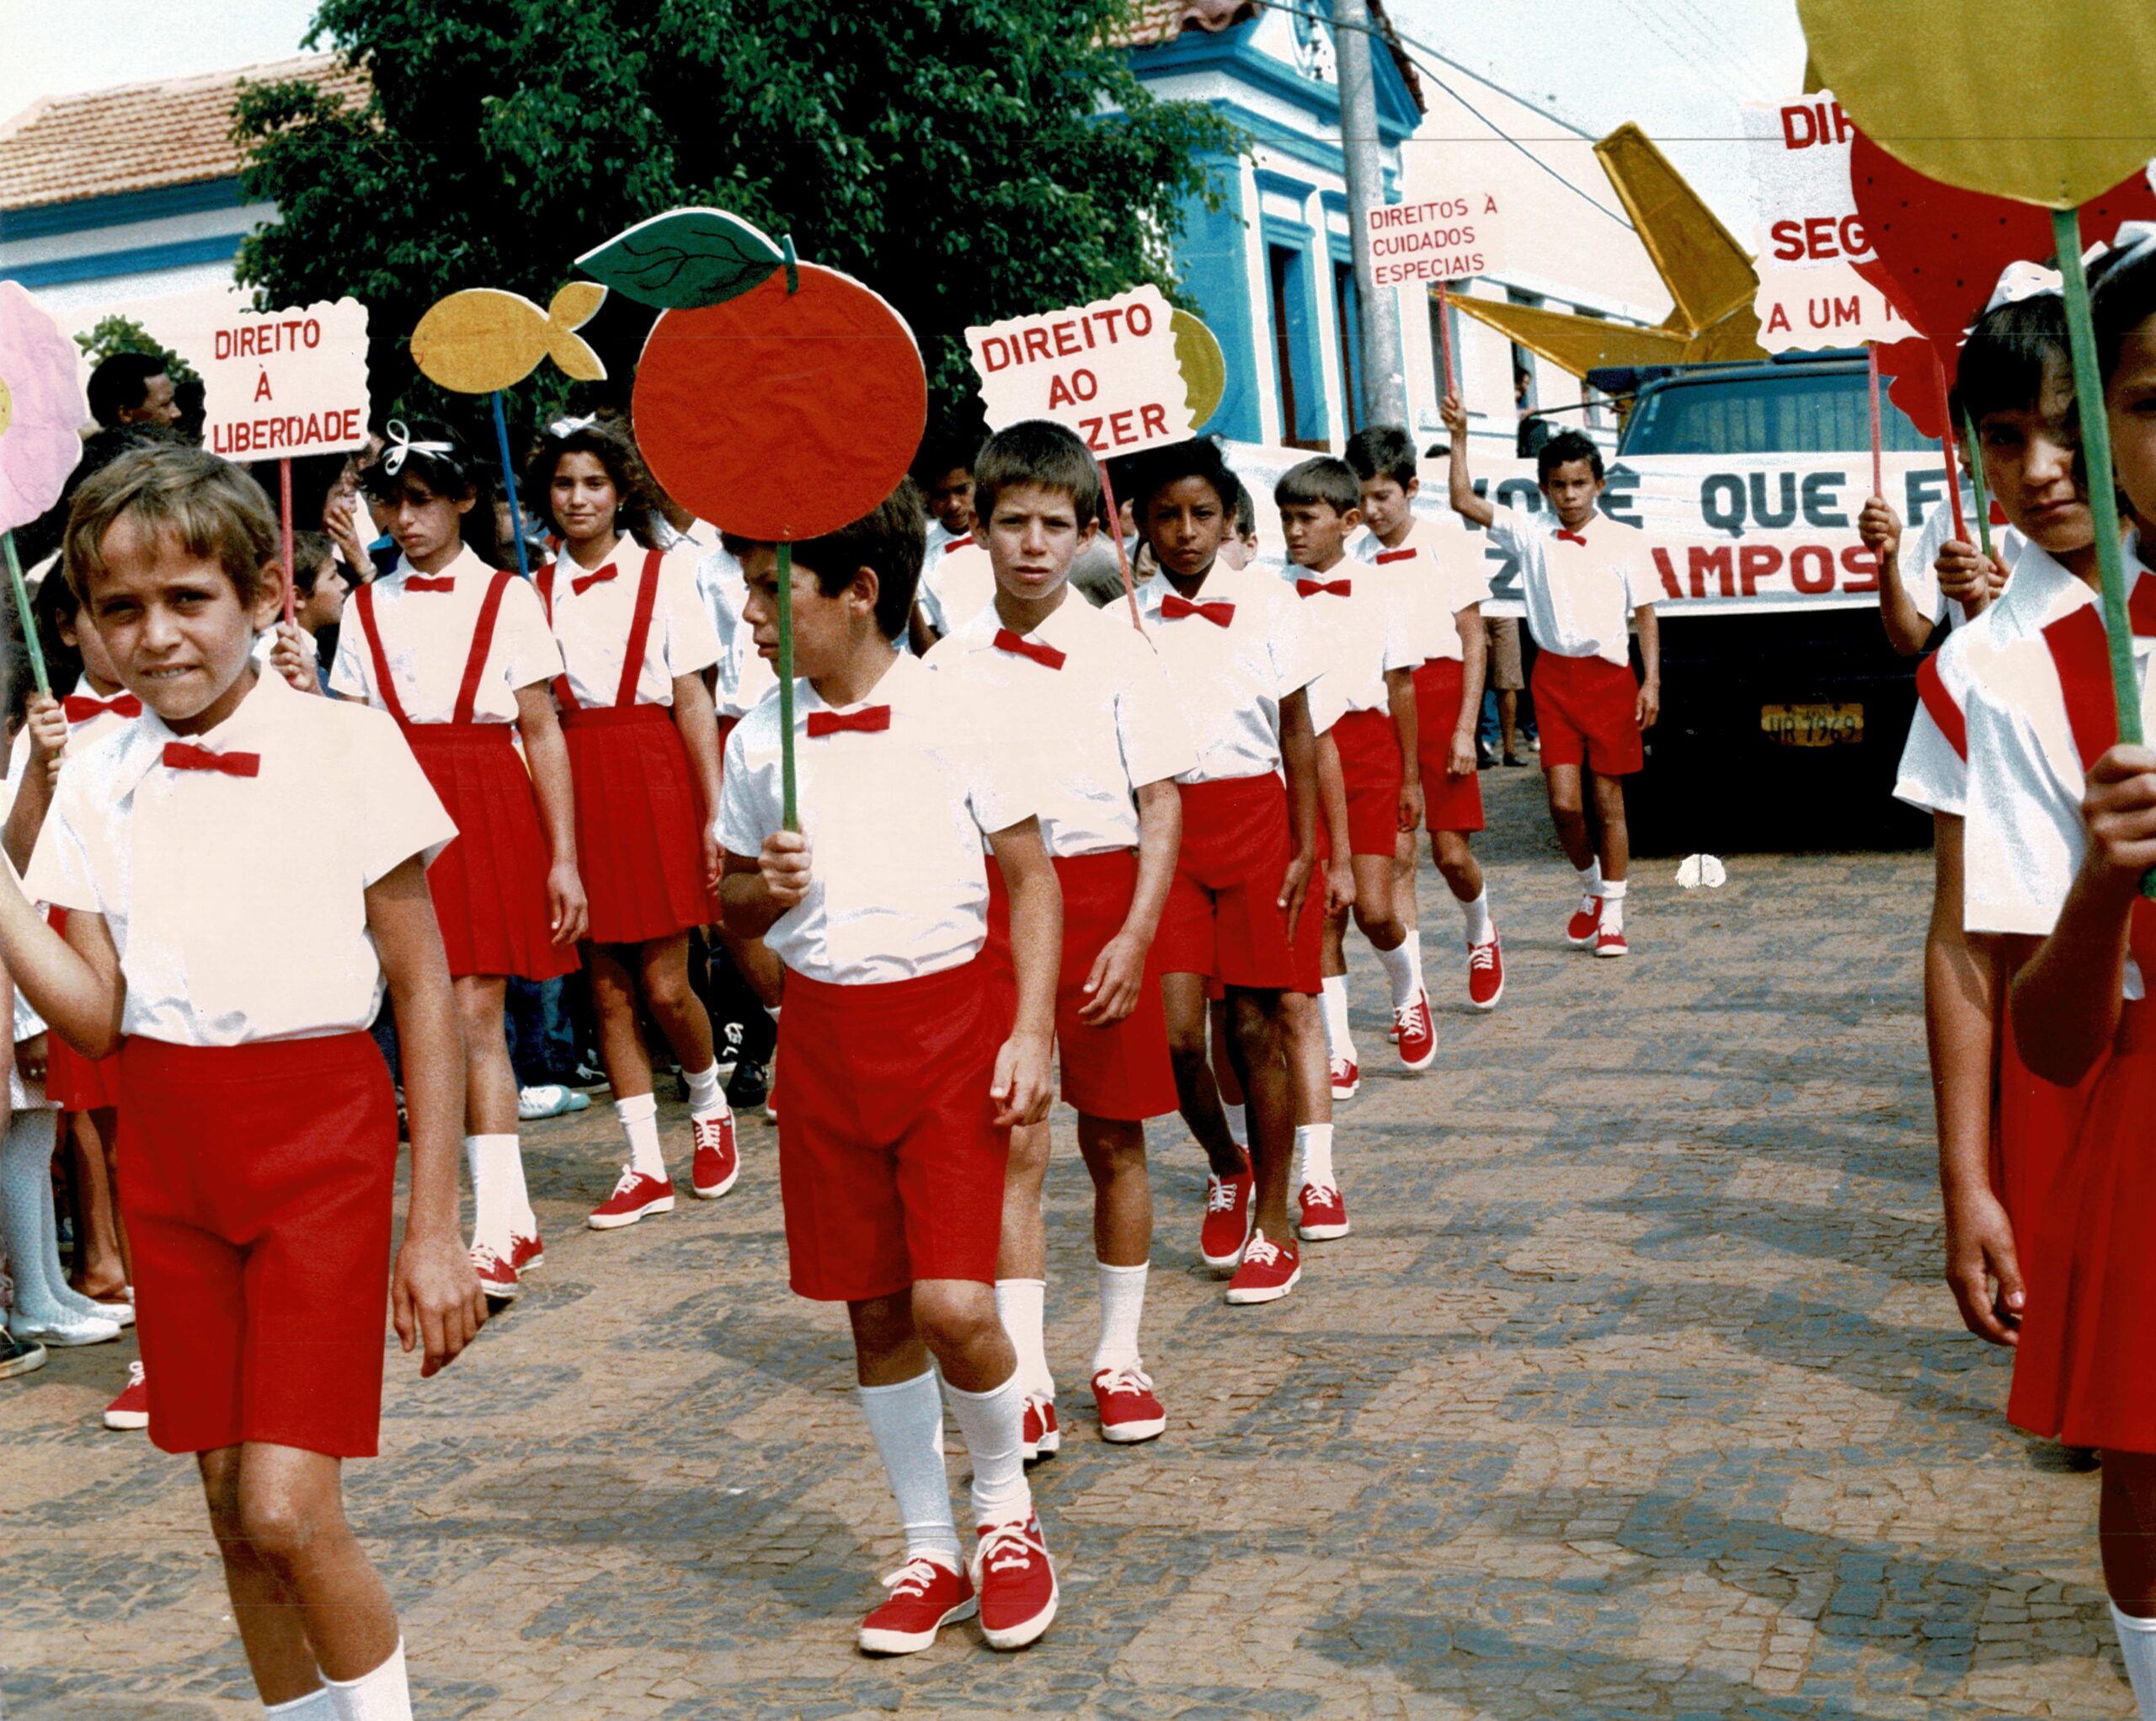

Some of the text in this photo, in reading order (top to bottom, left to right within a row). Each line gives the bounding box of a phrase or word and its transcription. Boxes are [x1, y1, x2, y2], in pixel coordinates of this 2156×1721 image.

[1370, 198, 1469, 230] DIREITOS
[1372, 226, 1476, 257] CUIDADOS
[1771, 214, 1871, 261] SEG
[1375, 253, 1485, 285] ESPECIAIS
[1767, 302, 1792, 334] A
[1808, 295, 1860, 329] UM
[215, 318, 321, 360] DIREITO
[981, 303, 1152, 372] DIREITO
[1049, 368, 1098, 410] AO
[213, 408, 361, 454] LIBERDADE
[1700, 472, 1849, 539] QUE
